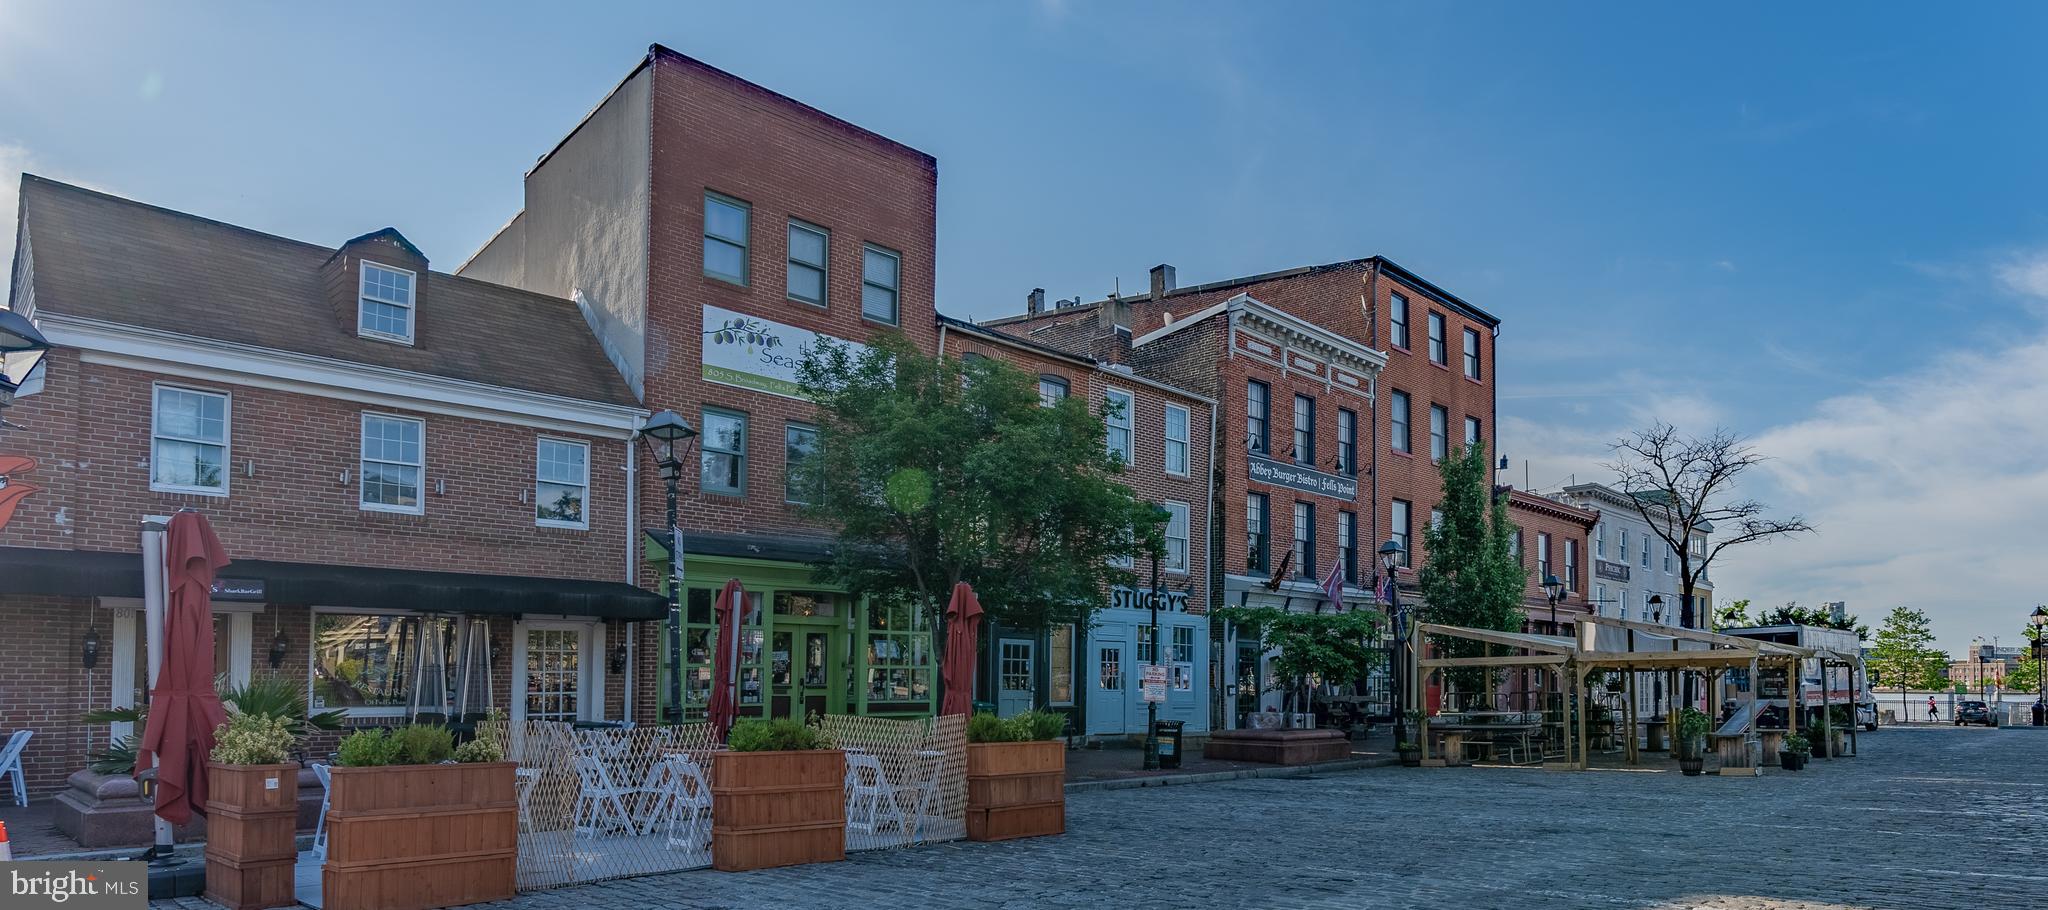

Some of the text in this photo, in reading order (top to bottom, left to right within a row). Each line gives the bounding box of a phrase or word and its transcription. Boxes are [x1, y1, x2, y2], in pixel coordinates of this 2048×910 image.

[760, 347, 803, 370] Seas
[707, 368, 724, 379] 805
[1250, 462, 1355, 496] Abbey Burger Bistro Fells Point
[1113, 589, 1188, 613] STUGGY'S
